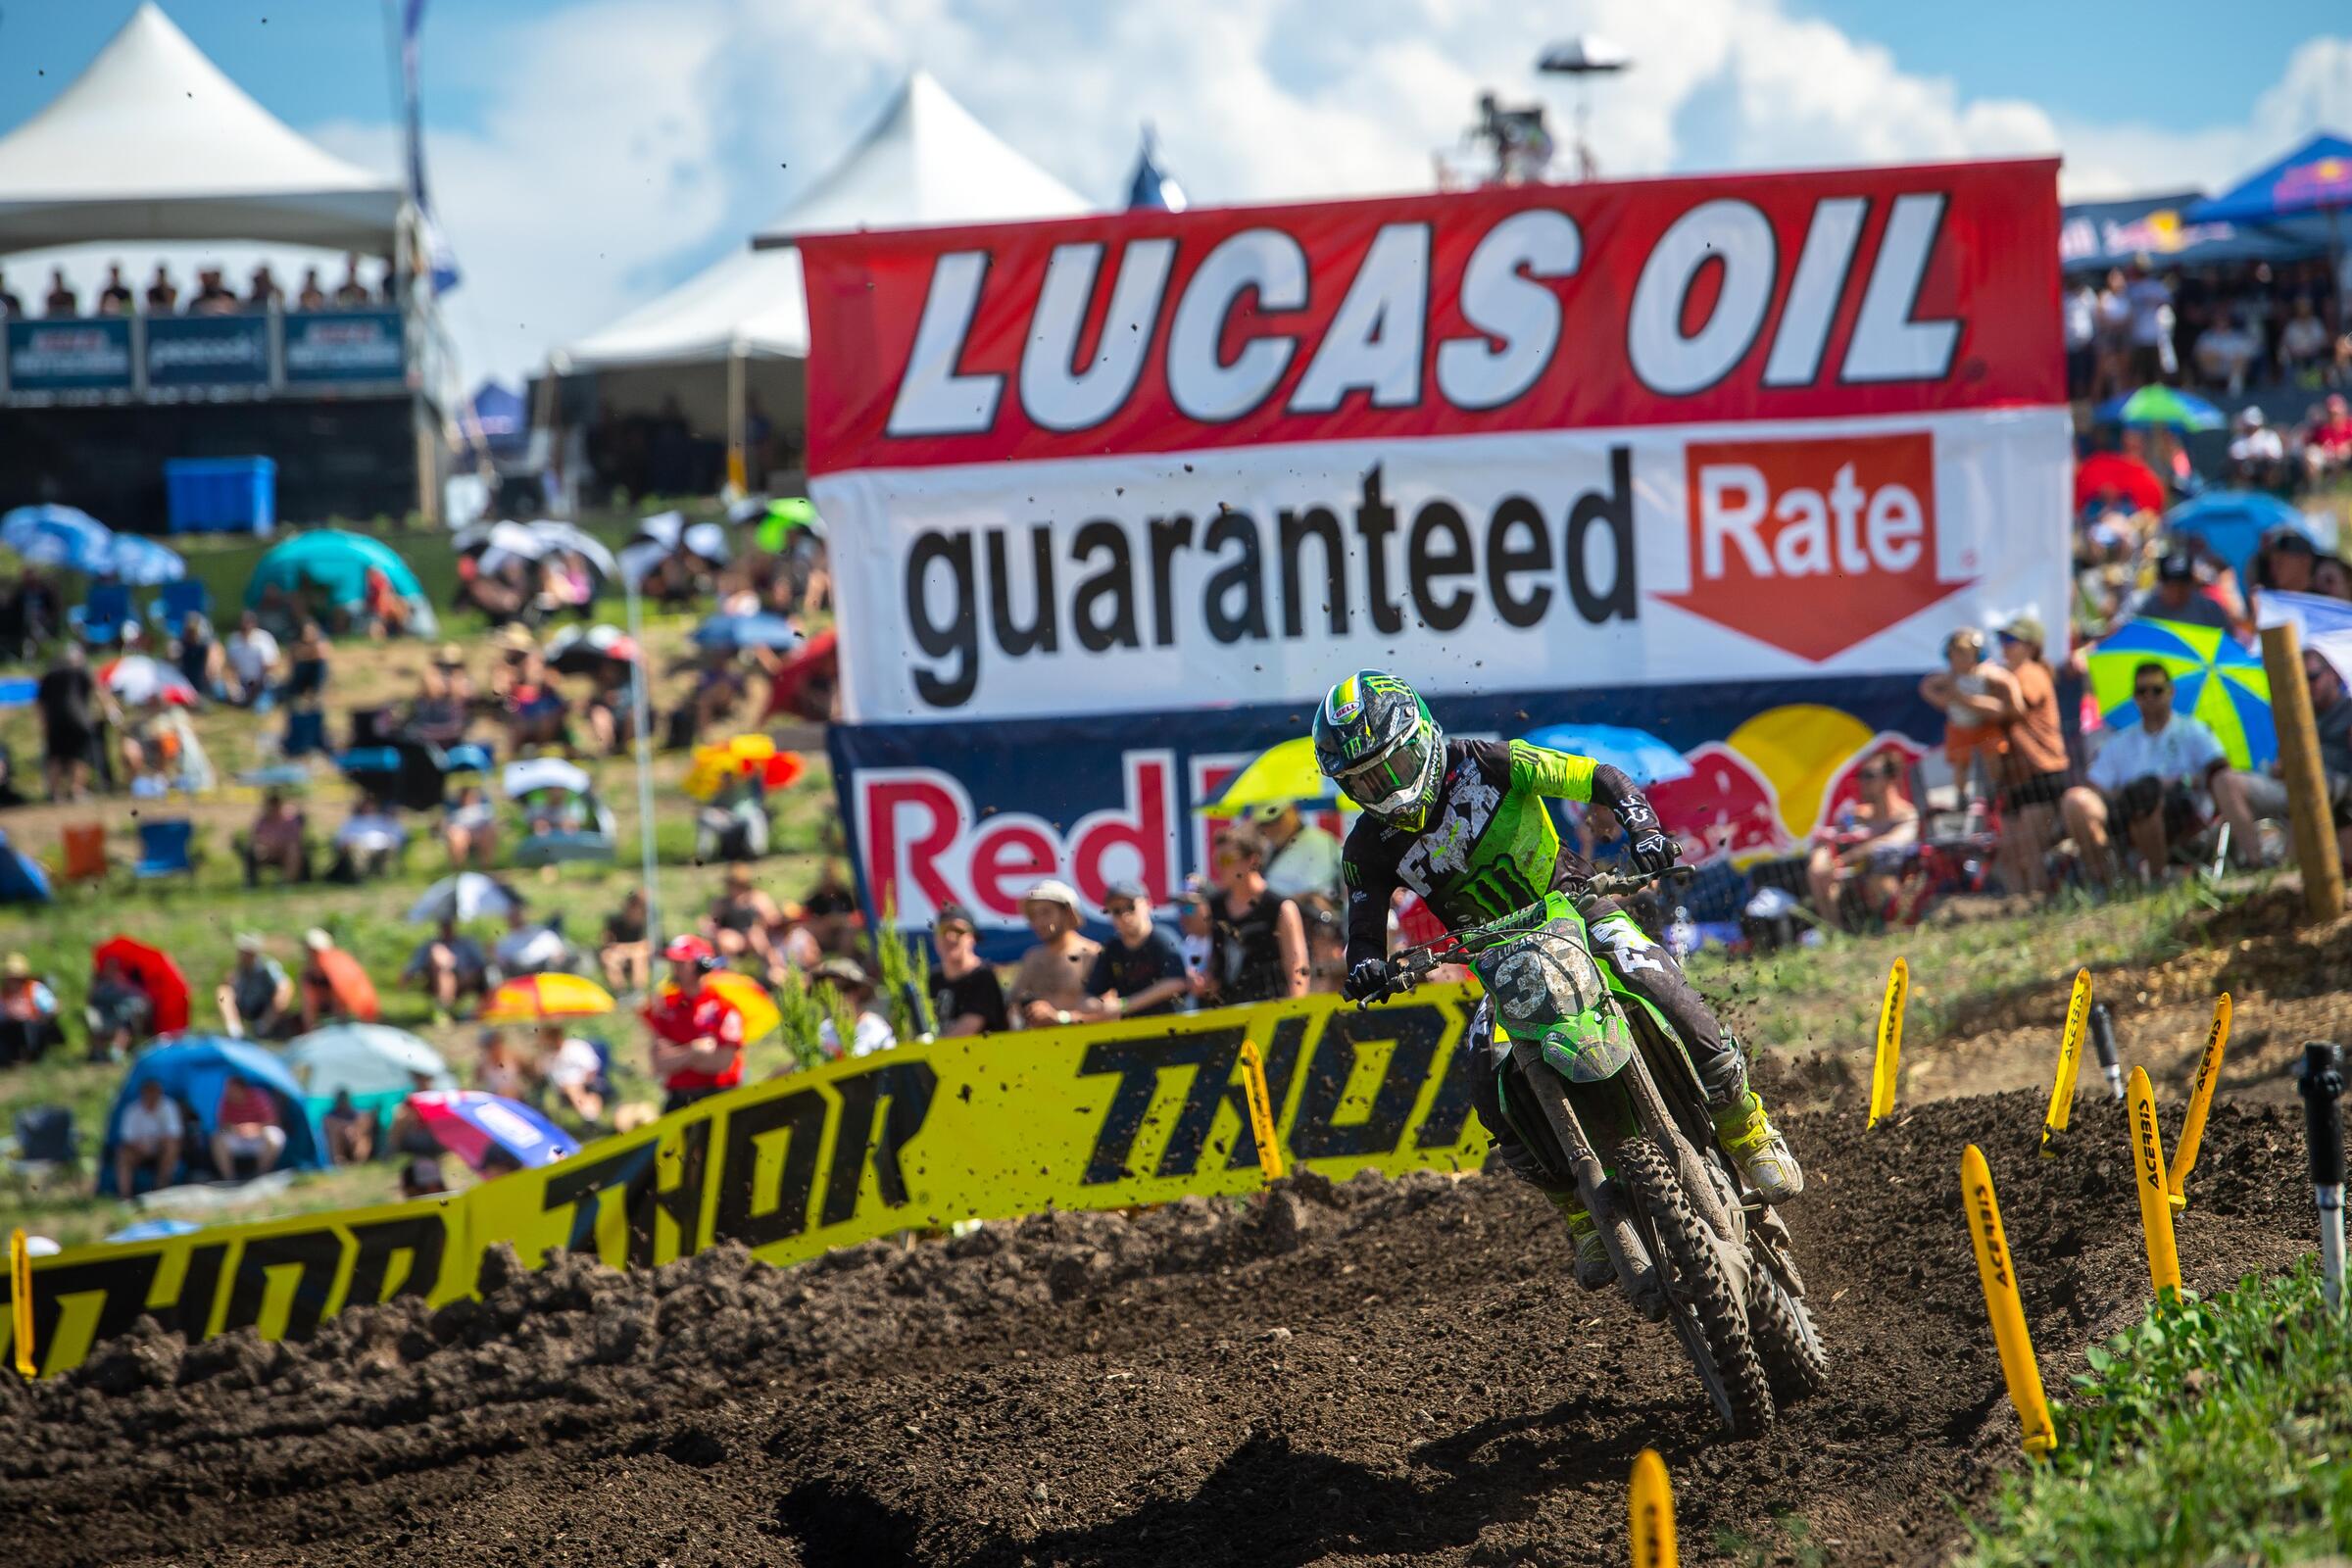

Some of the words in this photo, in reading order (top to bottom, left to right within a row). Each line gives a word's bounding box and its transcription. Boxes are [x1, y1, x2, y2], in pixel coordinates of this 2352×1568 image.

[885, 205, 1585, 439] LUCAS
[1627, 192, 1964, 397] OIL
[906, 444, 1639, 709] guaranteed
[1698, 461, 1924, 581] Rate
[1335, 703, 1357, 718] BELL
[856, 750, 1175, 931] Red
[1497, 935, 1534, 959] LUCAS
[2065, 991, 2085, 1061] ACERBIS
[2197, 1018, 2222, 1092] ACERBIS
[543, 1060, 938, 1270] THOR
[2138, 1099, 2160, 1190] ACERBIS
[1974, 1184, 2010, 1288] ACERBIS
